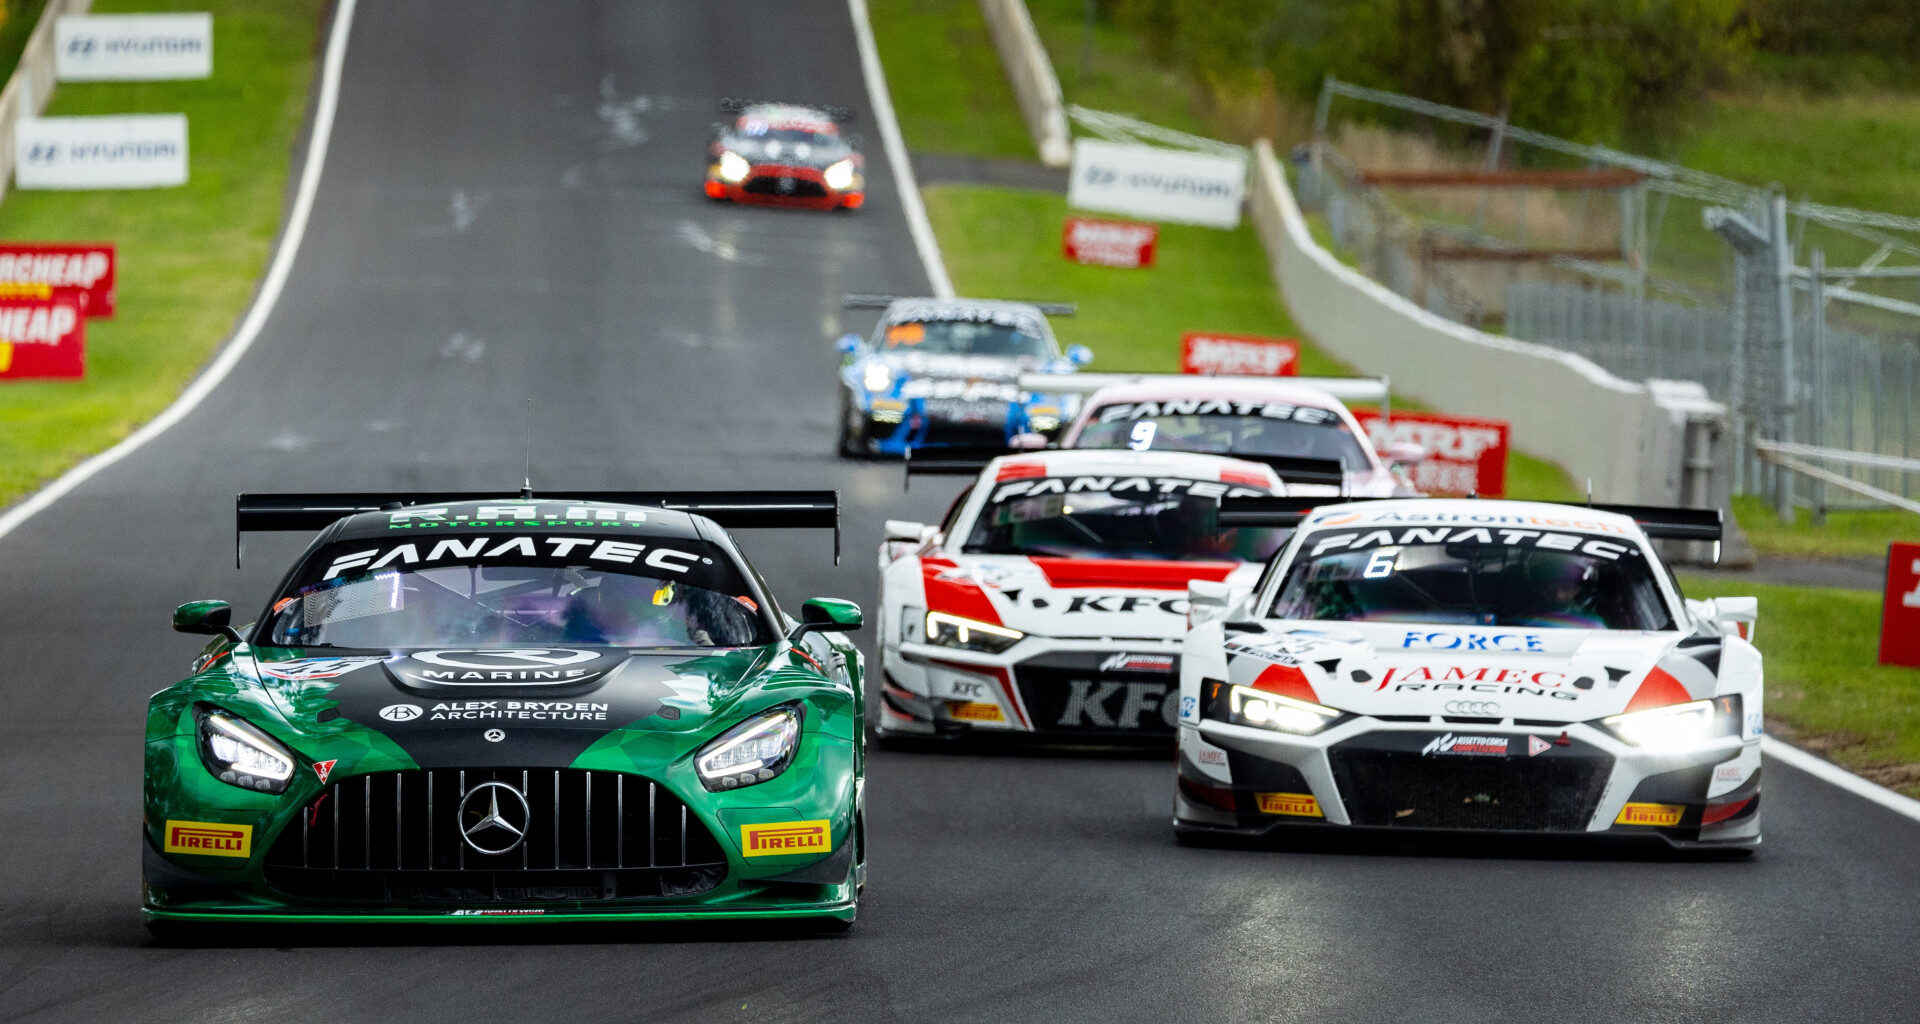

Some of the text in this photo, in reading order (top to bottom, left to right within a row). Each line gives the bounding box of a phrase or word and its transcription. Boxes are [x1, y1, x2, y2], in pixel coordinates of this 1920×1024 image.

[1101, 401, 1329, 424] FANATEC
[1129, 421, 1157, 451] 9
[389, 520, 643, 530] MOTORSPORT
[1363, 549, 1399, 579] 6
[1403, 632, 1545, 652] FORCE
[422, 668, 588, 681] MARINE
[1374, 666, 1566, 692] JAMEC
[953, 680, 985, 698] KFC
[1395, 684, 1580, 701] RACING
[430, 701, 608, 712] ALEX BRYDEN
[430, 710, 607, 720] ARCHITECTURE
[319, 760, 329, 783] TOW
[1262, 795, 1314, 814] PIRELLI
[1625, 806, 1679, 823] PIRELLI
[170, 827, 244, 851] PIRELLI
[749, 826, 824, 851] PIRELLI
